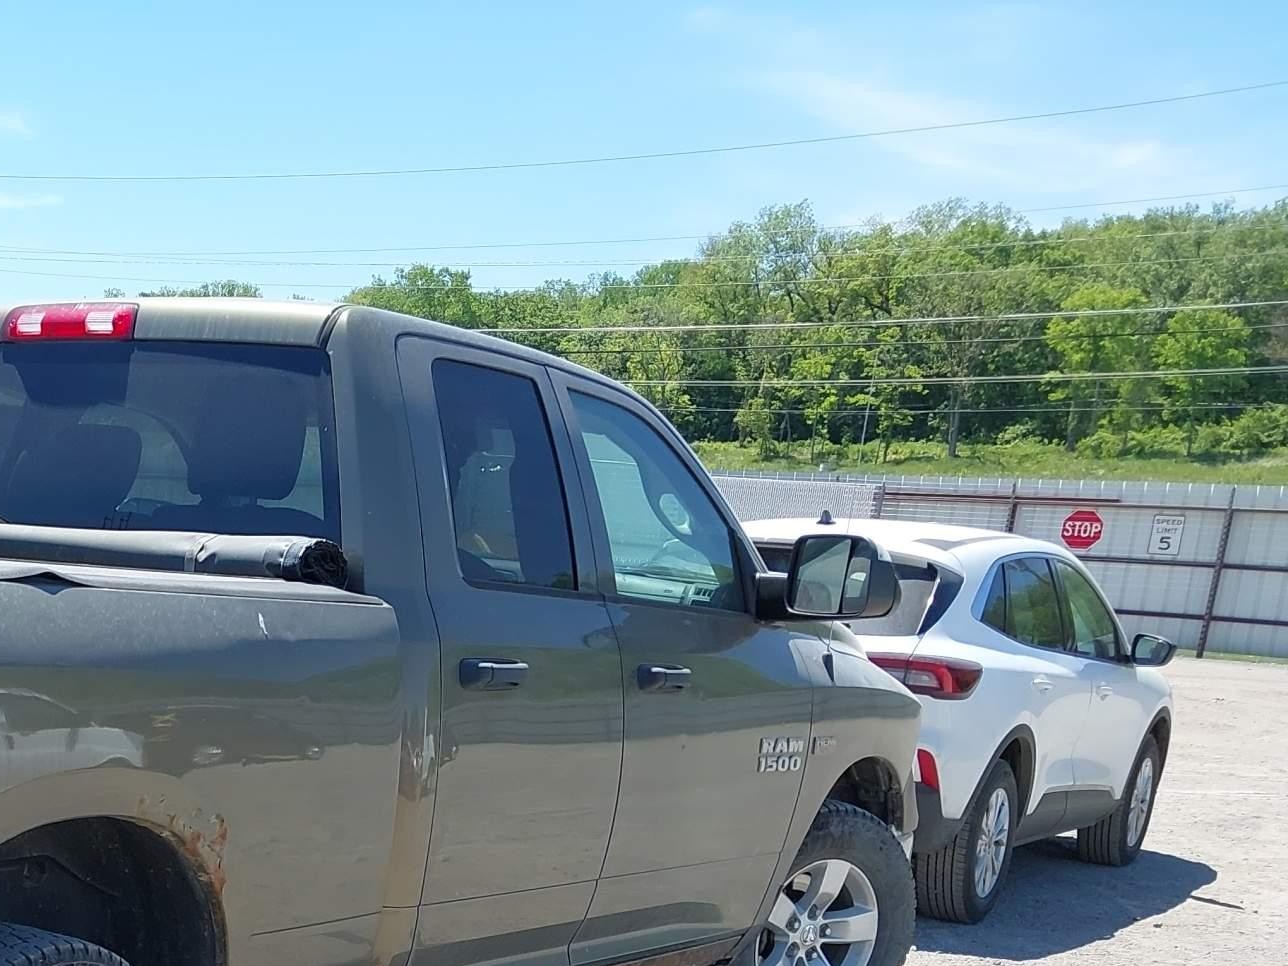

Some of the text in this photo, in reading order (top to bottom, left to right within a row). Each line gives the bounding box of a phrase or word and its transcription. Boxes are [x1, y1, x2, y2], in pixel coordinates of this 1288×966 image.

[1063, 521, 1101, 538] STOP
[1155, 518, 1183, 526] SPEED
[1158, 536, 1172, 551] 5
[760, 738, 805, 753] RAM
[758, 755, 802, 773] 1500
